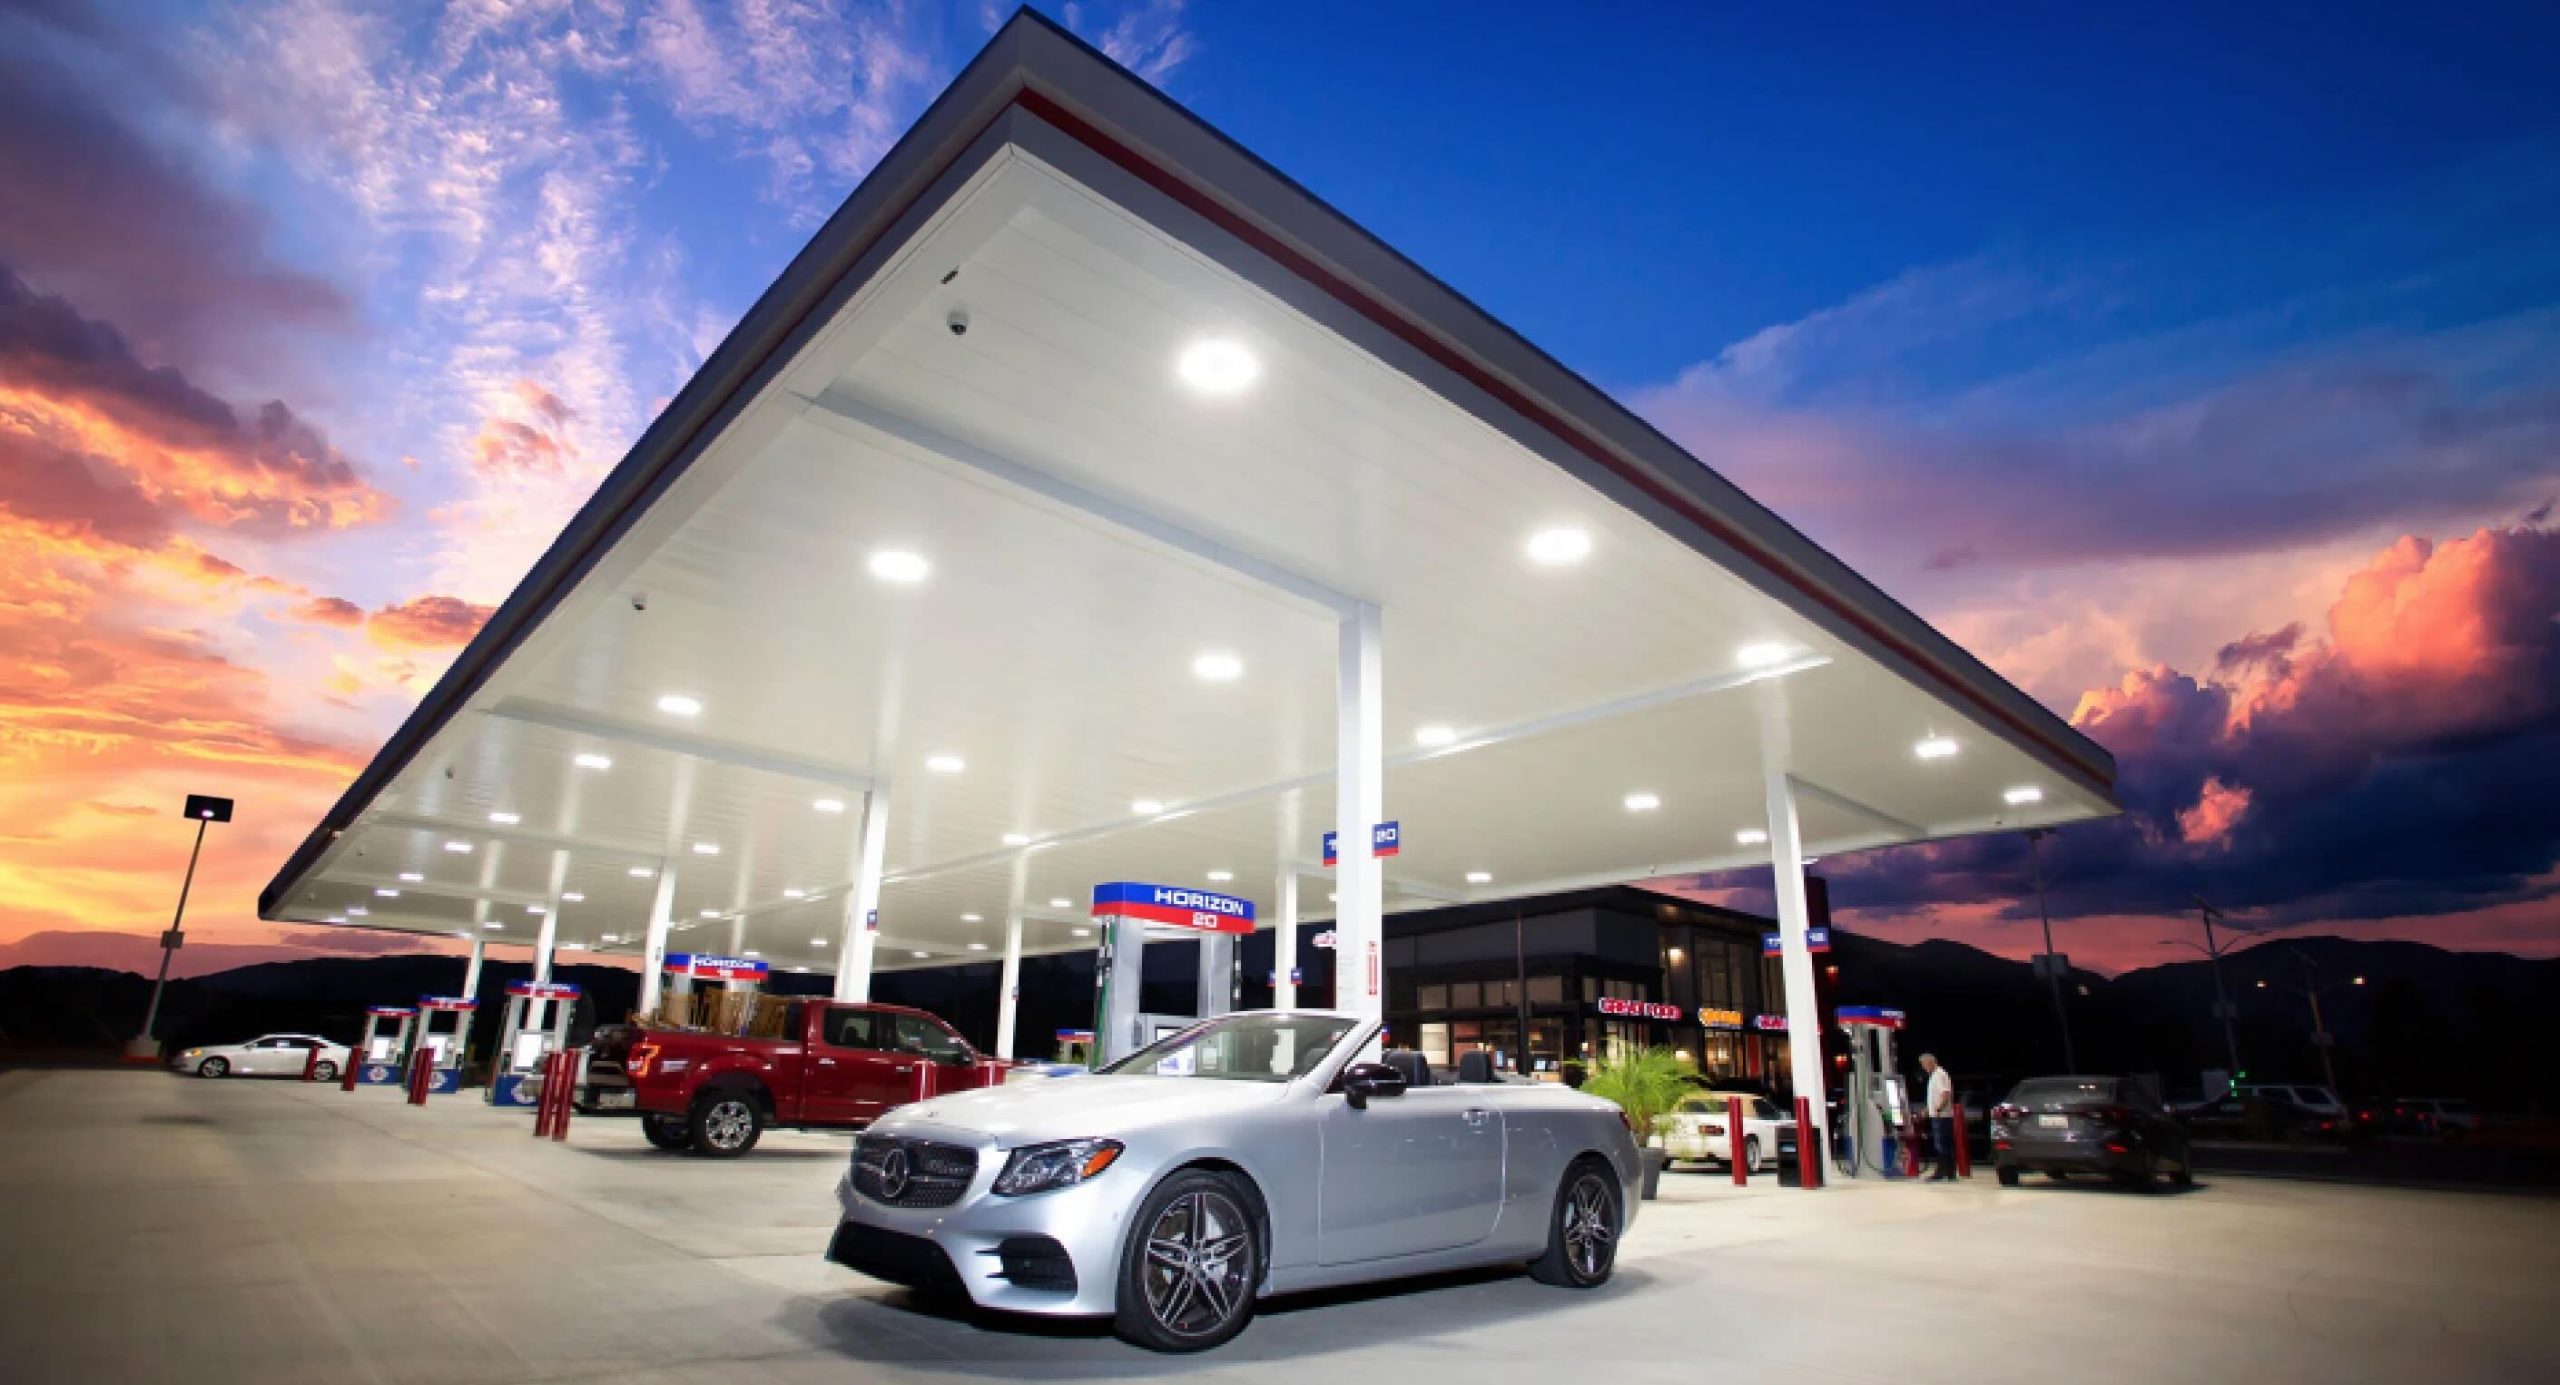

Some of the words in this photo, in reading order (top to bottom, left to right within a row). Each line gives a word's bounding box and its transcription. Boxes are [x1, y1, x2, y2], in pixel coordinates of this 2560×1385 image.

[1376, 828, 1396, 843] 20
[1154, 887, 1244, 916] HORIZON
[1192, 911, 1218, 928] 20
